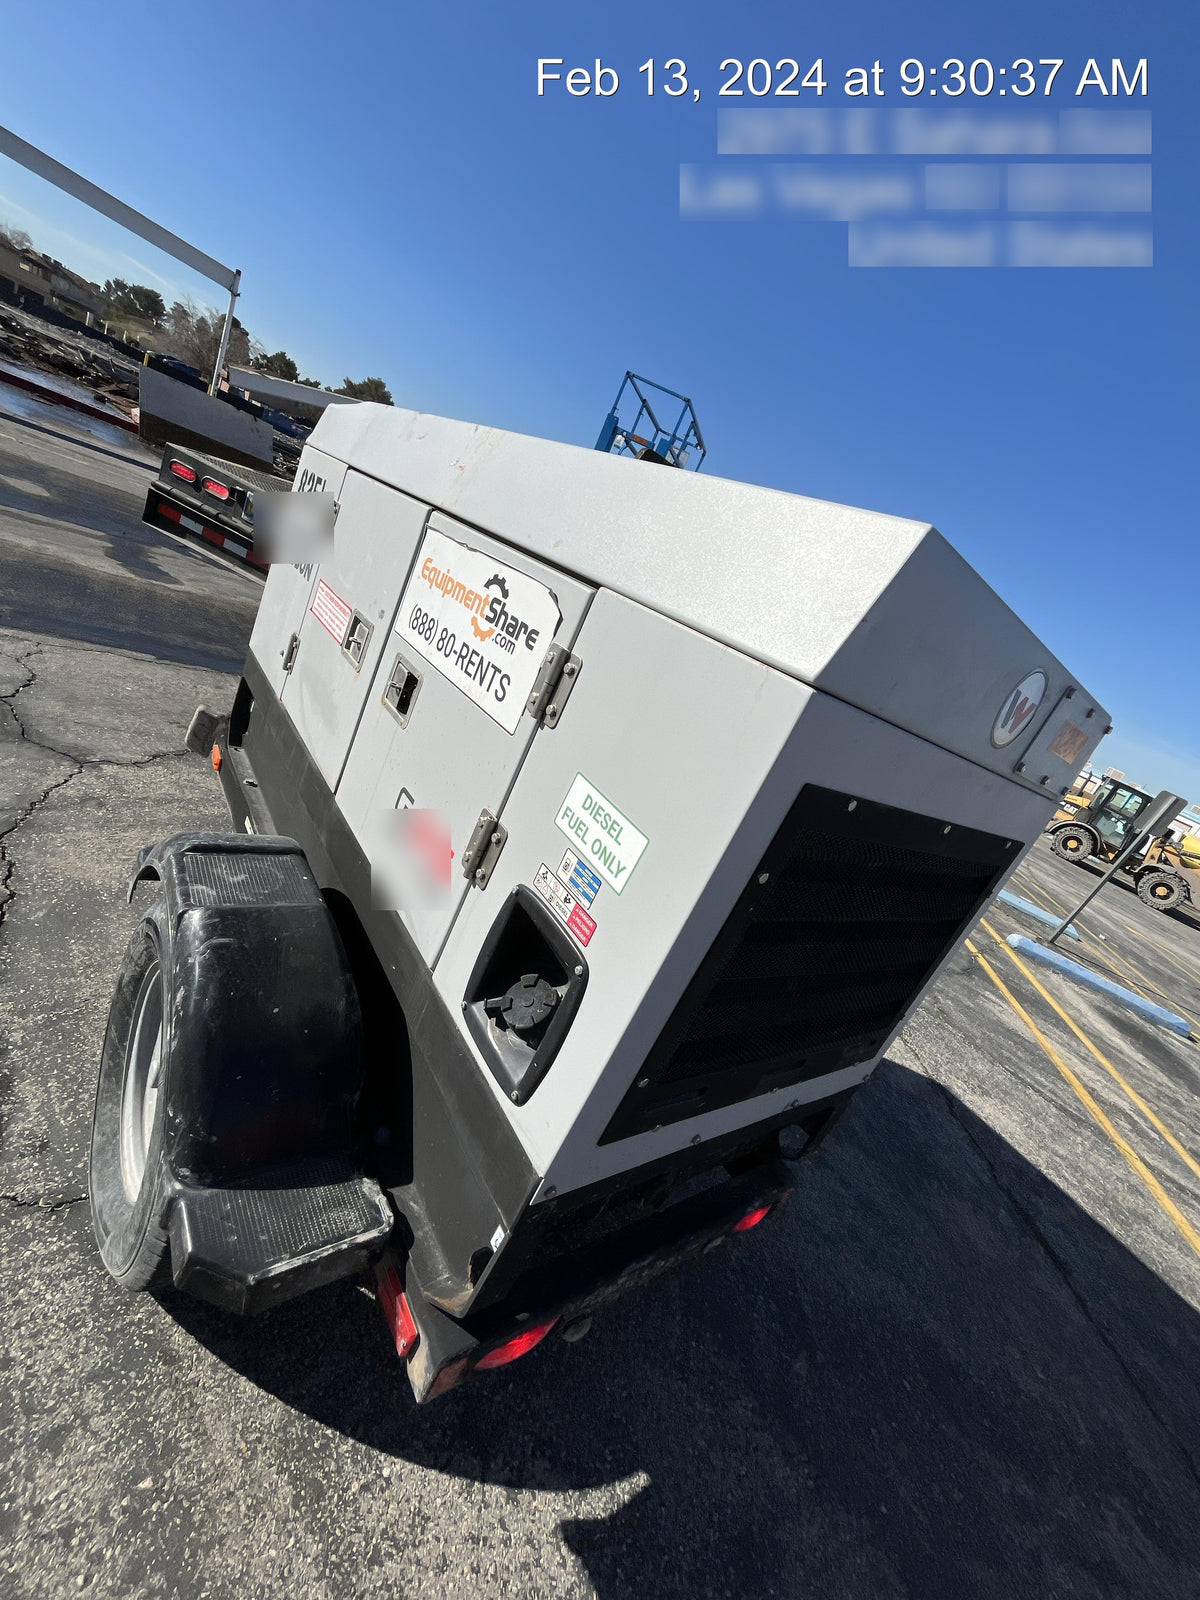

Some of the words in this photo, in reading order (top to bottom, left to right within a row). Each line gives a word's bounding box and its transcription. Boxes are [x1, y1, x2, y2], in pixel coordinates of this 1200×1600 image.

[421, 557, 541, 652] EquipmentShare
[409, 603, 439, 645] (888)
[436, 630, 511, 702] 80-RENTS
[561, 805, 588, 845] FUEL
[590, 837, 627, 880] ONLY
[582, 792, 624, 846] DIESEL
